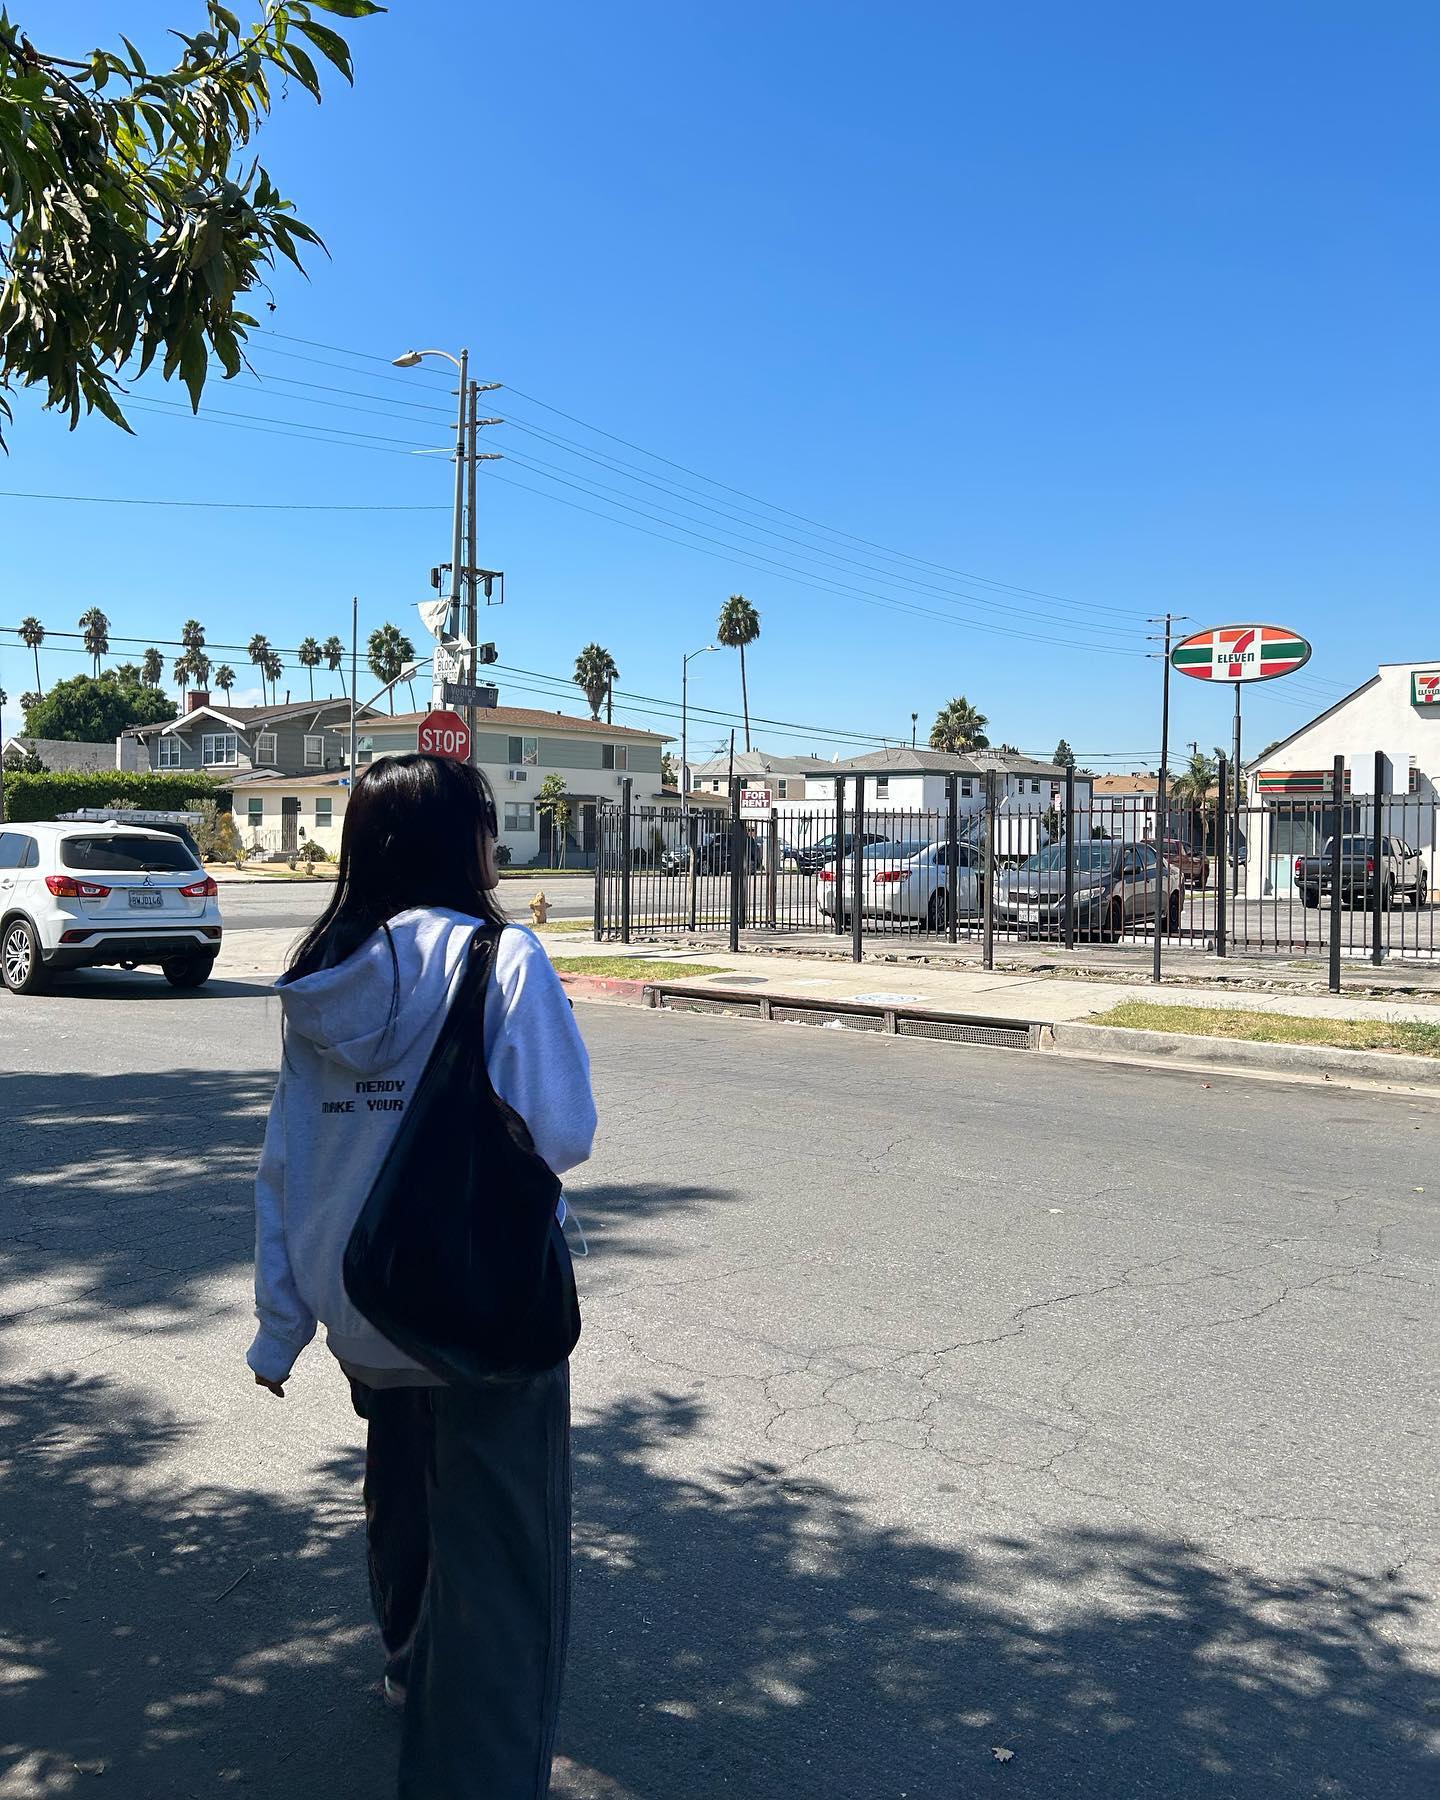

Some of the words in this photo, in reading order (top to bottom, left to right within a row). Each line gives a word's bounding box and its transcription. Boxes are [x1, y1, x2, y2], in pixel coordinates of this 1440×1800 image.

[436, 648, 445, 659] DO
[1219, 629, 1255, 677] 7
[437, 660, 456, 671] BLOCK
[450, 685, 476, 698] Venice
[421, 728, 467, 753] STOP
[366, 1099, 404, 1111] YOUR
